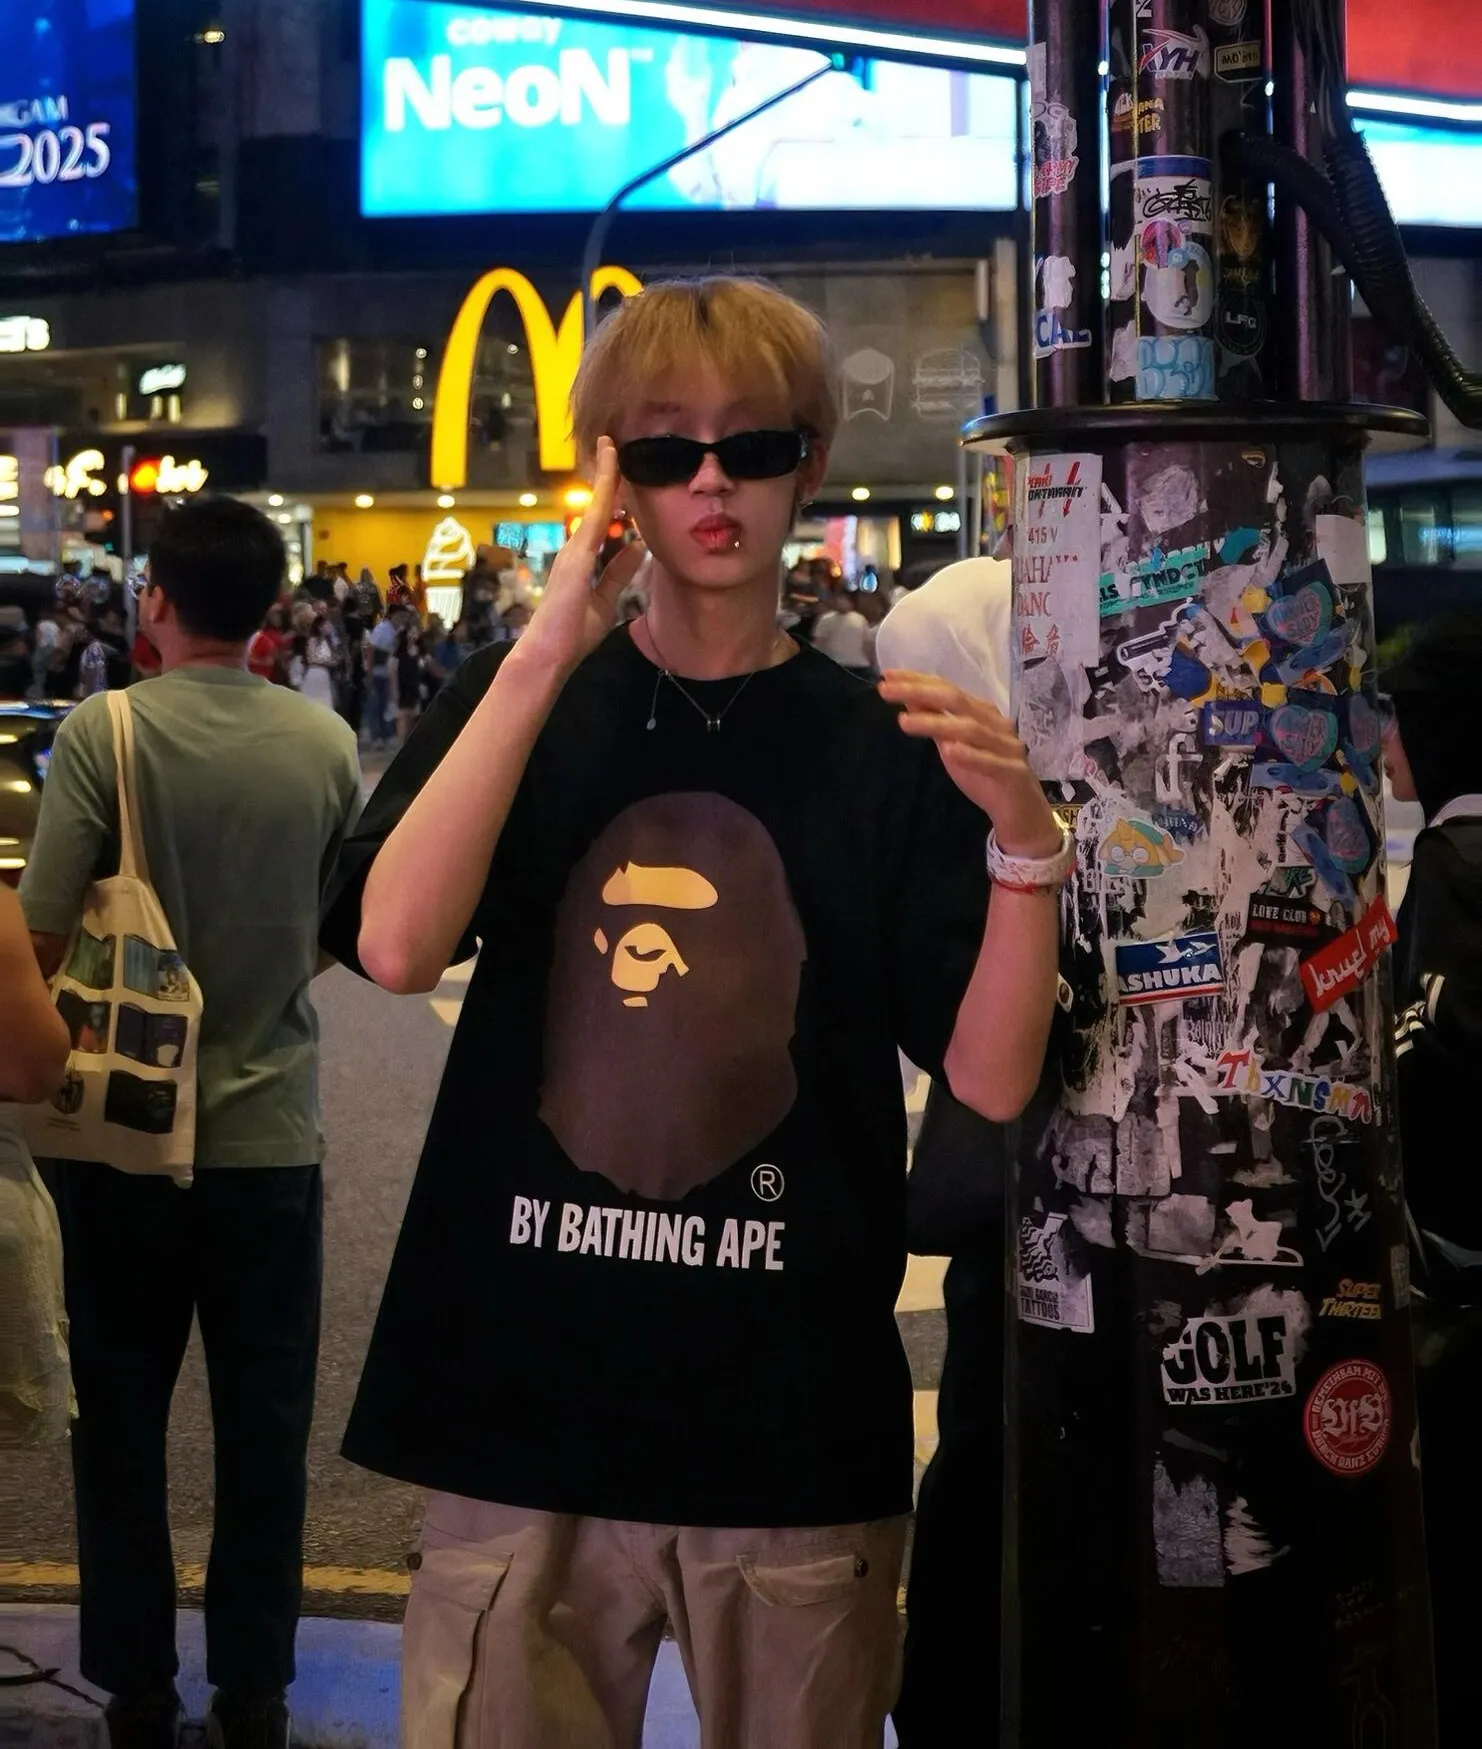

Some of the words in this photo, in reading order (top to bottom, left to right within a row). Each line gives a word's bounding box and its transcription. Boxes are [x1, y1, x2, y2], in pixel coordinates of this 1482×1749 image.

[384, 47, 631, 131] NeoN
[0, 122, 111, 187] 2025
[1050, 526, 1058, 544] V
[509, 1196, 550, 1247] BY
[558, 1203, 705, 1266] BATHING
[716, 1218, 785, 1270] APE
[1163, 1315, 1287, 1384] GOLF
[1166, 1387, 1211, 1402] WAS
